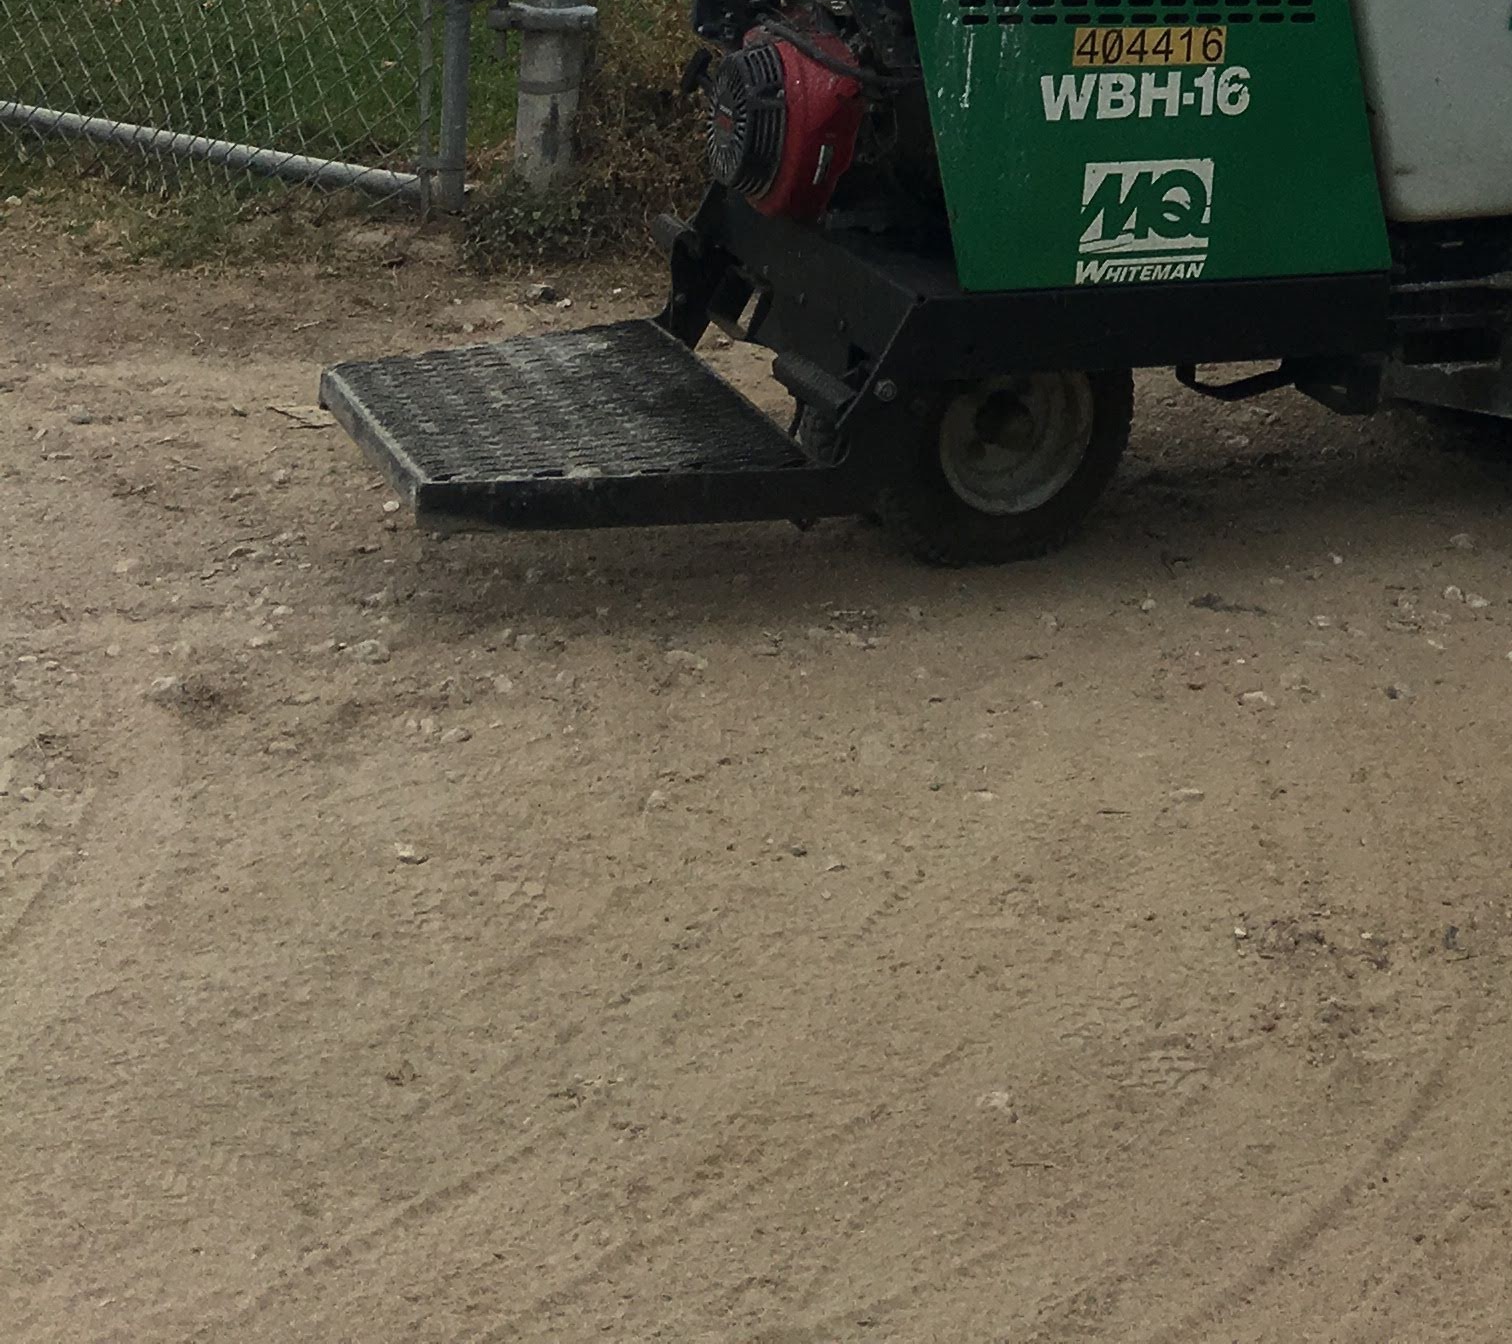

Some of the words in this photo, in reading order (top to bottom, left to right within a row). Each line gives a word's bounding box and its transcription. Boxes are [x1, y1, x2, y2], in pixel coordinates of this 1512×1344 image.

[1075, 27, 1224, 64] 404416
[1040, 66, 1251, 120] WBH-16
[1075, 255, 1206, 285] WHITEMAN
